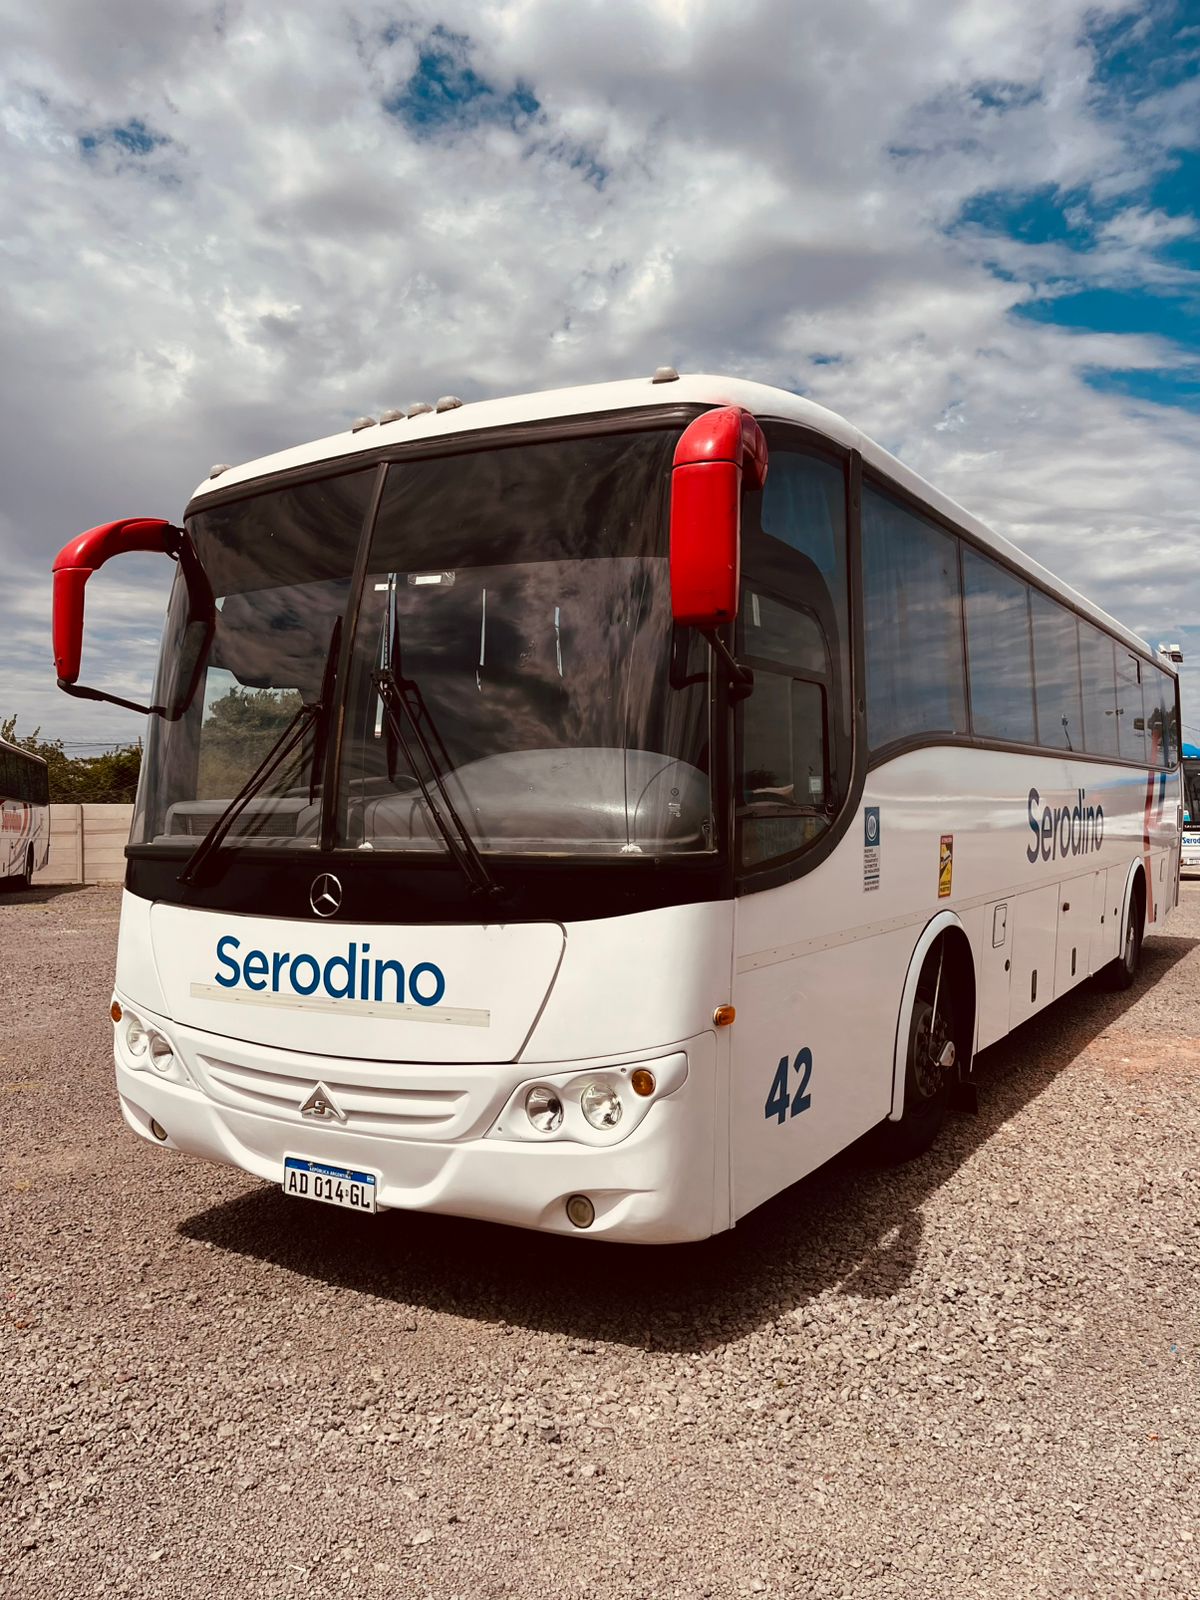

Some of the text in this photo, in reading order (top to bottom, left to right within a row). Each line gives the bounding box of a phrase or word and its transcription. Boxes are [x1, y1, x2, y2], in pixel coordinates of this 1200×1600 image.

[1027, 788, 1104, 863] Serodino
[214, 935, 446, 1006] Serodino
[765, 1047, 812, 1125] 42
[289, 1171, 370, 1208] AD 014 GL
